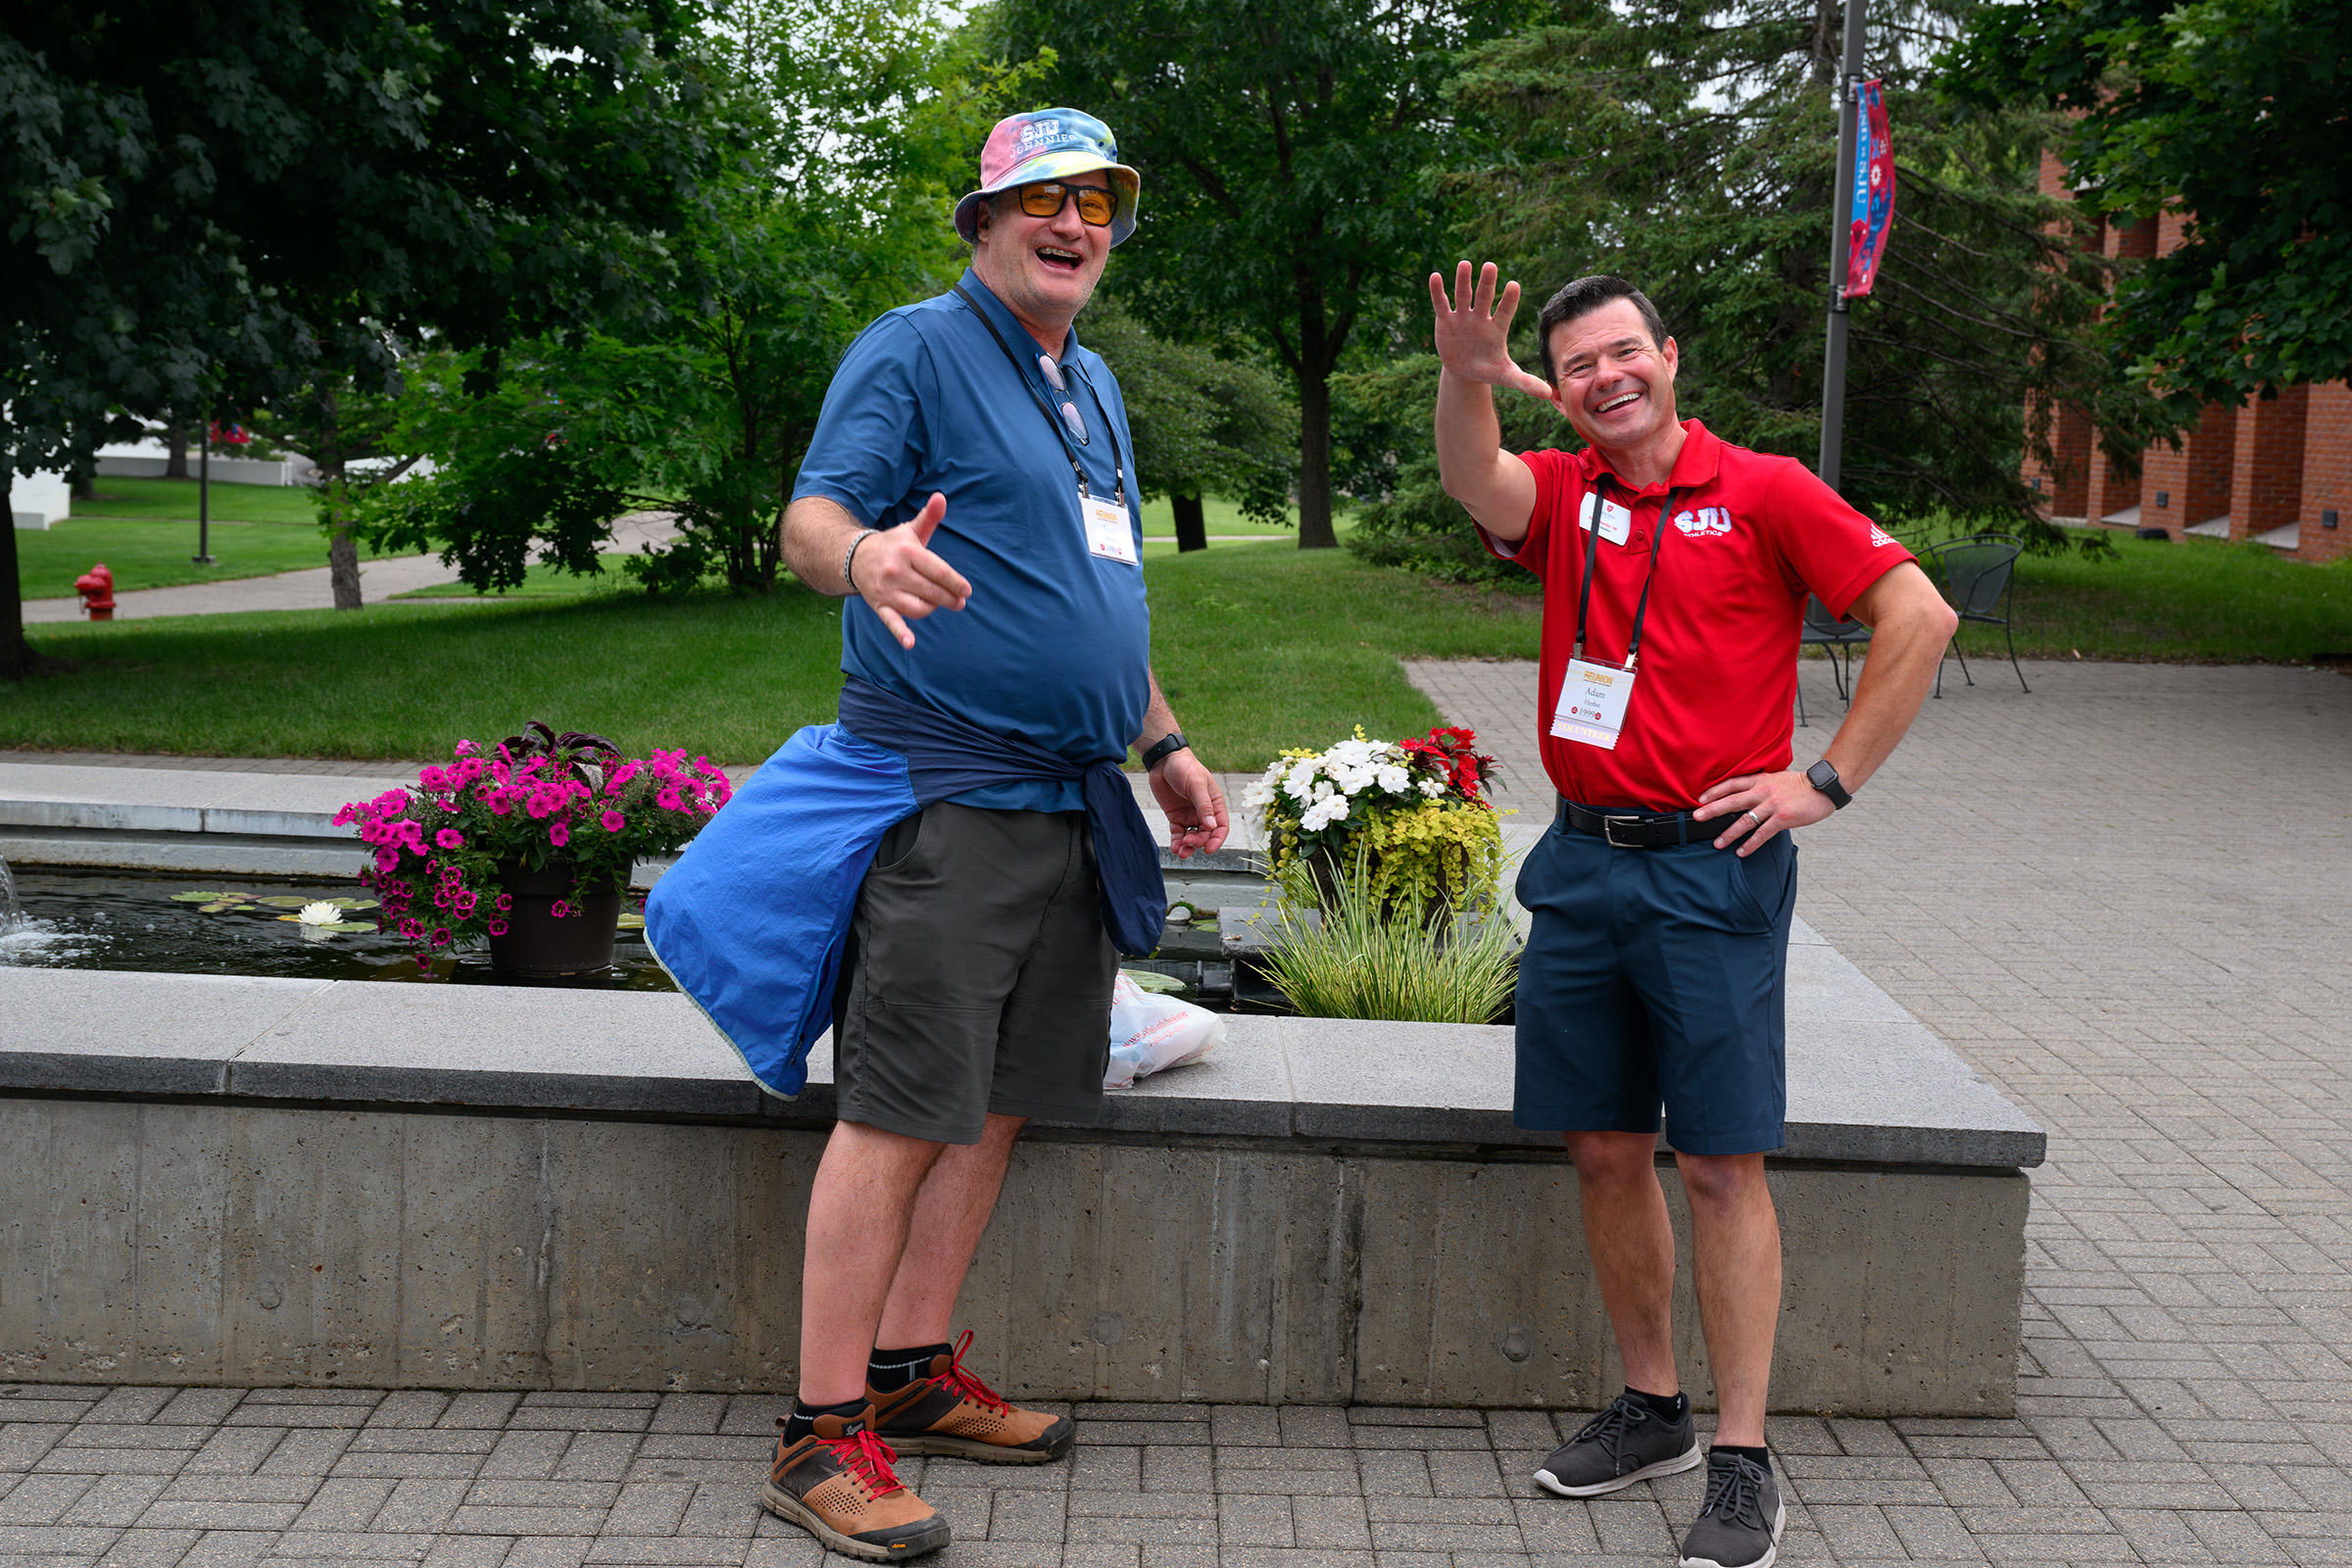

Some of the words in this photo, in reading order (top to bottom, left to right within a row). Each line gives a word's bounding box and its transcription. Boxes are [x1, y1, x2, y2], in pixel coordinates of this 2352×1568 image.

[1020, 120, 1059, 143] SJU
[1009, 133, 1078, 159] JOHNNIES
[1856, 161, 1868, 204] SJU
[1674, 507, 1733, 534] SJU
[1584, 670, 1613, 684] REUNION
[1585, 687, 1605, 699] Adam
[1580, 708, 1595, 717] 1999
[1558, 722, 1611, 741] VOLUNTEER
